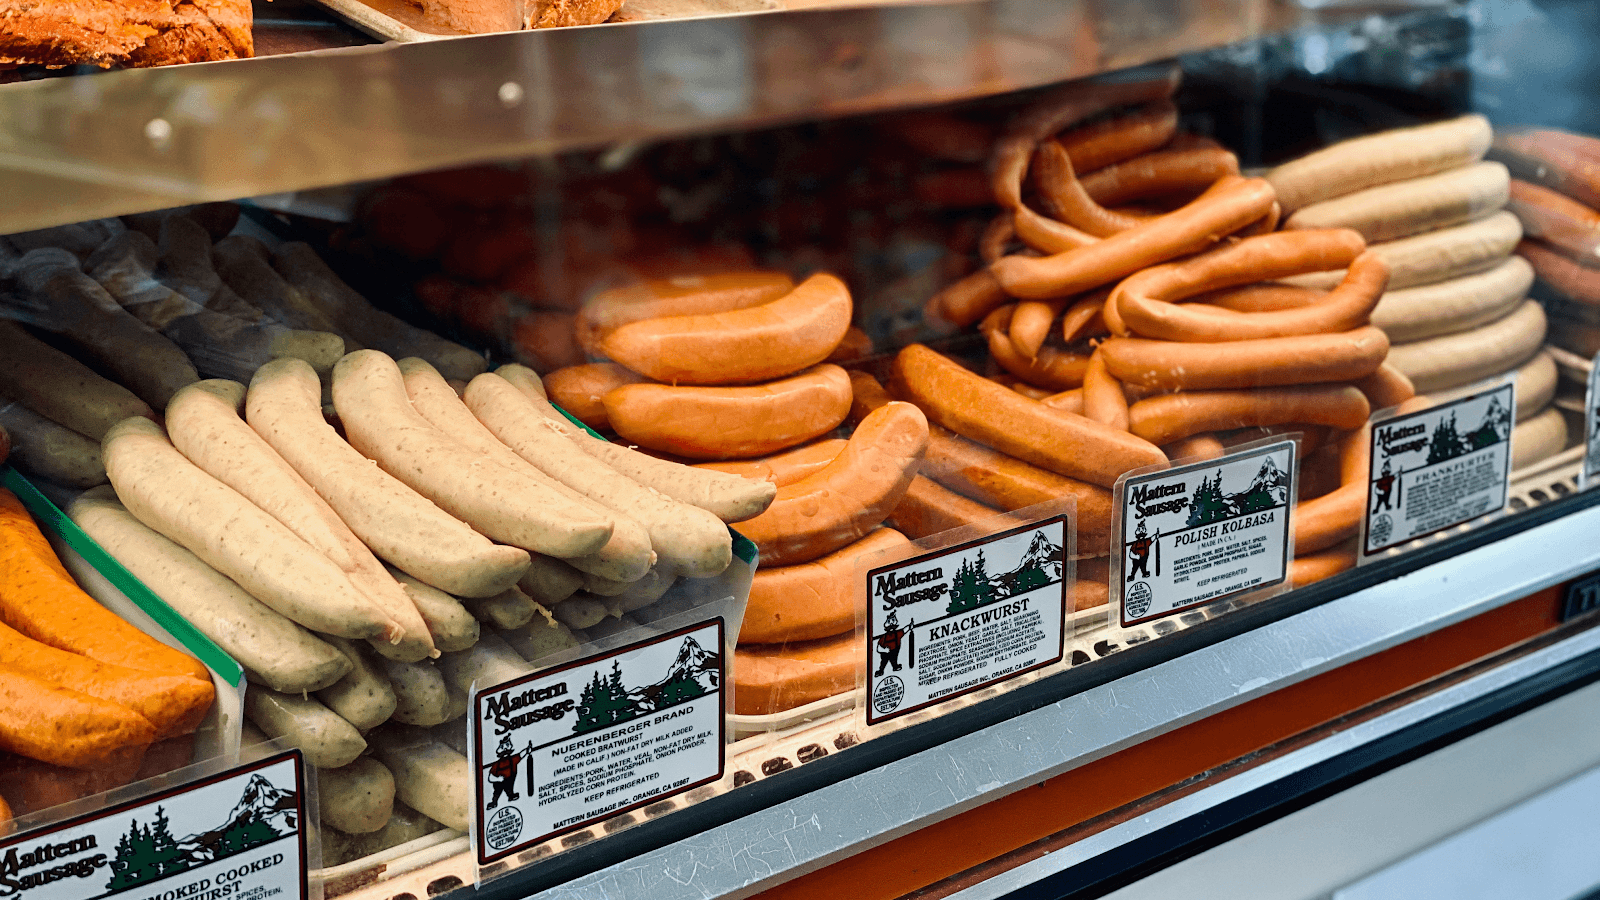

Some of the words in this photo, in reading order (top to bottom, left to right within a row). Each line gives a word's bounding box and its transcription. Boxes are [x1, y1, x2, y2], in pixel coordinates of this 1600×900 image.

[1129, 482, 1186, 506] Mattern
[1135, 496, 1188, 519] Sausage
[1174, 526, 1218, 548] POLISH
[1221, 512, 1275, 535] KOLBASA
[875, 567, 943, 596] Mattern
[1197, 578, 1210, 588] KEEP
[1212, 567, 1248, 583] REFRIGERATED
[883, 583, 948, 611] Sausage
[1172, 597, 1194, 608] MATTERN
[1194, 591, 1214, 601] SAUSAGE
[929, 597, 1030, 642] KNACKWURST
[943, 660, 987, 681] REFRIGERATED
[995, 652, 1012, 663] FULLY
[1014, 643, 1037, 656] COOKED
[484, 682, 568, 719] Mattern
[928, 686, 953, 700] MATTERN
[954, 678, 978, 691] SAUSAGE
[495, 699, 574, 735] Sausage
[552, 720, 650, 758] NUERENBERGER
[655, 706, 694, 724] BRAND
[554, 764, 576, 777] (MADE
[578, 761, 584, 769] IN
[611, 743, 639, 758] NON-FAT
[641, 738, 653, 748] DRY
[656, 733, 669, 743] MILK
[672, 725, 693, 737] ADDED
[564, 747, 596, 763] COOKED
[598, 733, 643, 753] BRATWURST
[608, 756, 632, 770] WATER,
[654, 740, 681, 755] NON-FAT
[683, 735, 695, 745] DRY
[560, 779, 586, 793] SPICES,
[587, 769, 613, 783] SODIUM
[656, 748, 676, 760] ONION
[539, 787, 584, 807] HYDROLYZED
[586, 780, 605, 791] CORN
[585, 791, 604, 804] KEEP
[606, 771, 660, 796] REFRIGERATED
[499, 808, 511, 819] U.S.
[553, 813, 585, 830] MATTERN
[586, 802, 617, 818] SAUSAGE
[633, 787, 661, 802] ORANGE,
[663, 783, 671, 792] CA
[215, 853, 284, 885] COOKED
